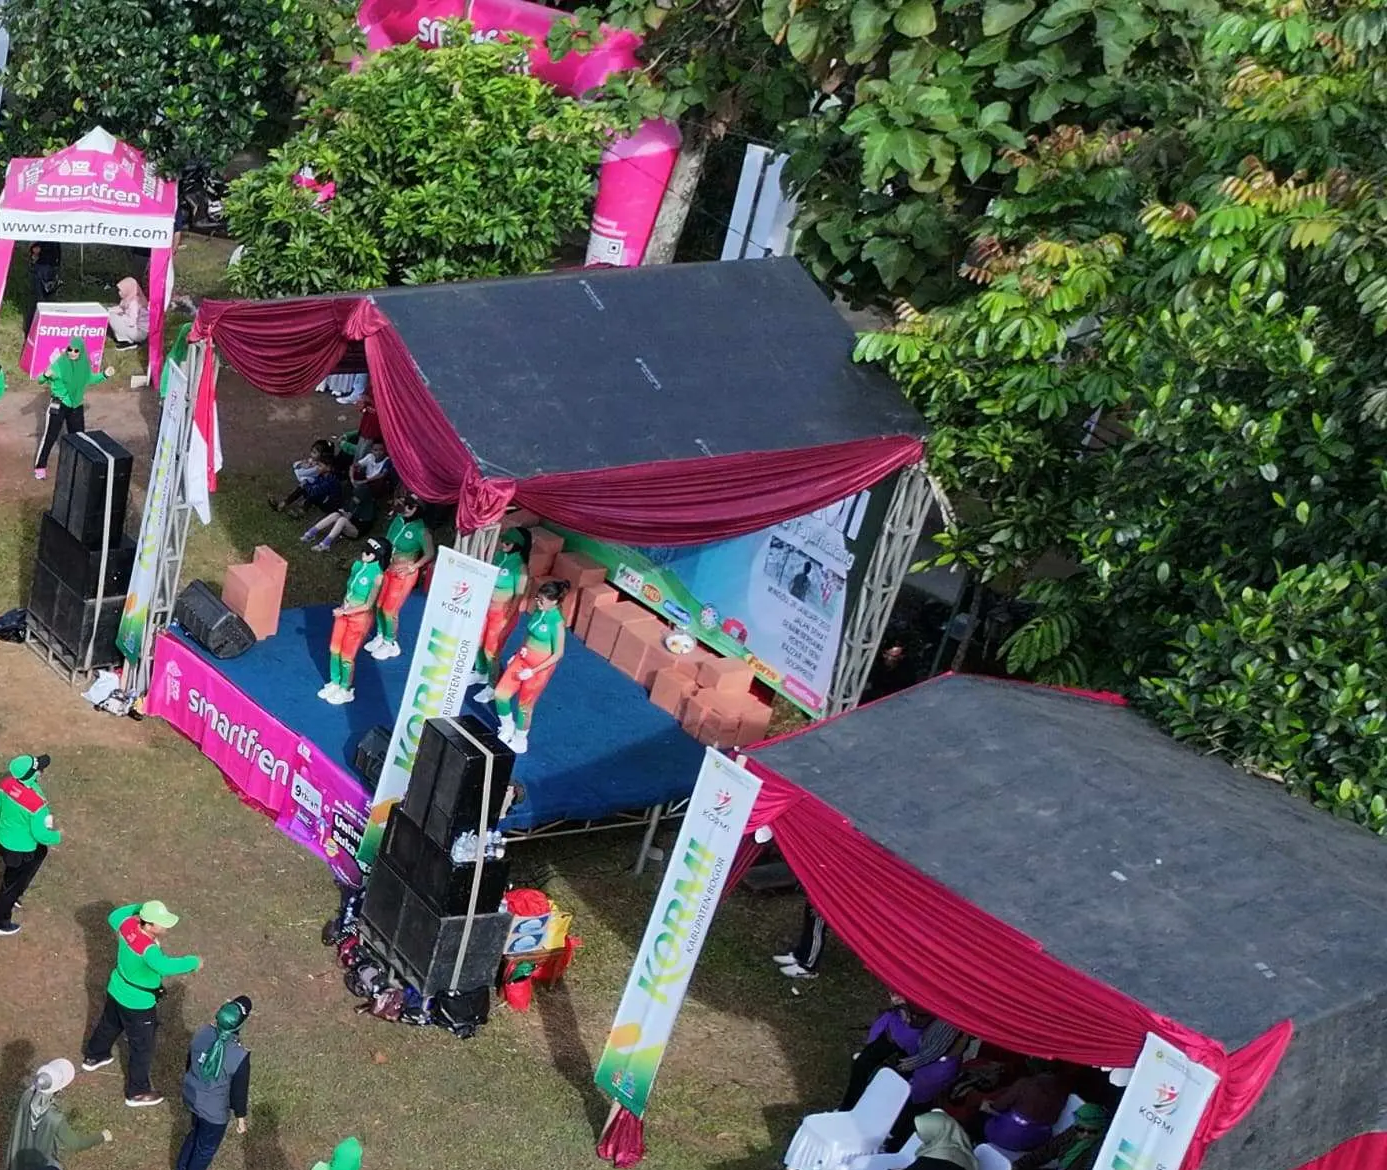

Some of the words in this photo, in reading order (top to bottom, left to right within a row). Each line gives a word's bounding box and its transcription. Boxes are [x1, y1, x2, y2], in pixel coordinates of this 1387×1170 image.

[36, 182, 141, 203] smartfren
[2, 220, 168, 241] www.smartfren.com
[39, 324, 105, 337] smartfren
[441, 601, 472, 618] KORMI
[443, 672, 461, 716] BUPATEN
[453, 639, 471, 673] BOGOR
[393, 627, 459, 773] KORMI
[188, 688, 290, 786] smartfren
[334, 814, 363, 842] Unlim
[686, 897, 711, 954] KABUPATEN
[708, 857, 725, 897] BOGOR
[638, 837, 715, 1005] KORMI
[1138, 1106, 1174, 1135] KORMI
